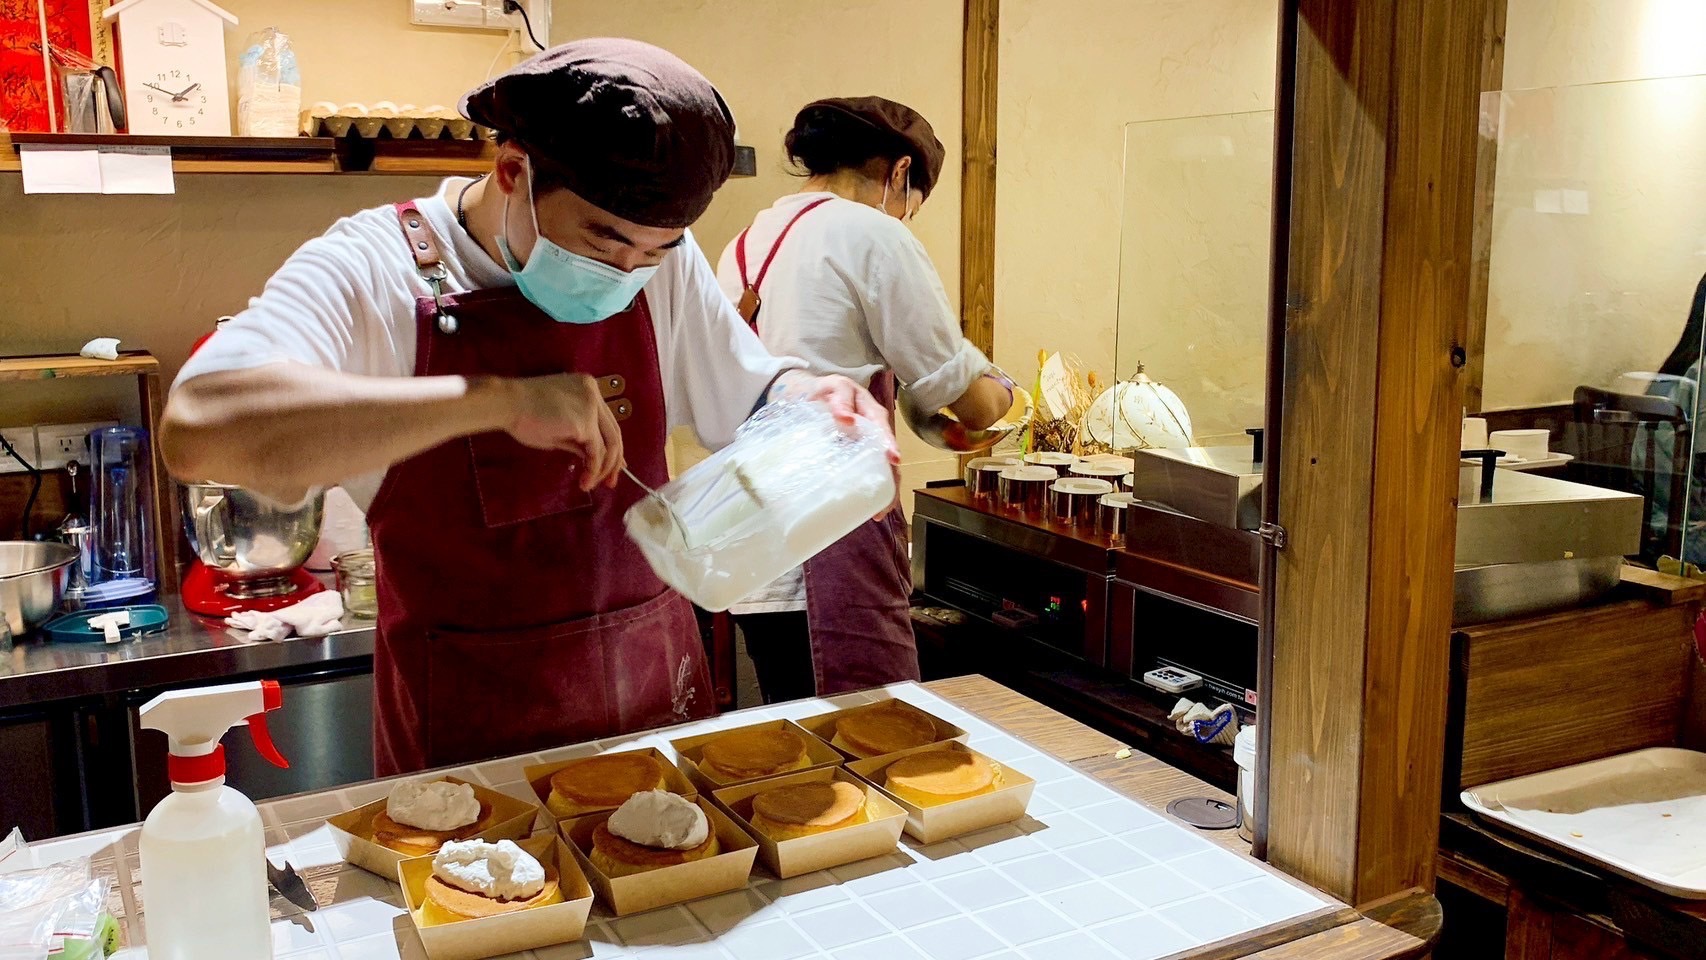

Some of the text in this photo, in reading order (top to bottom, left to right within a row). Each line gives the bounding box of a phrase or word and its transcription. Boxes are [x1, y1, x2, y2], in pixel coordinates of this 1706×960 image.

[157, 73, 166, 81] 11
[170, 70, 181, 78] 12
[196, 83, 201, 91] 2
[147, 94, 153, 103] 9
[201, 96, 207, 104] 3
[153, 107, 158, 115] 8
[163, 116, 168, 124] 7
[176, 120, 182, 128] 6
[189, 117, 195, 125] 5
